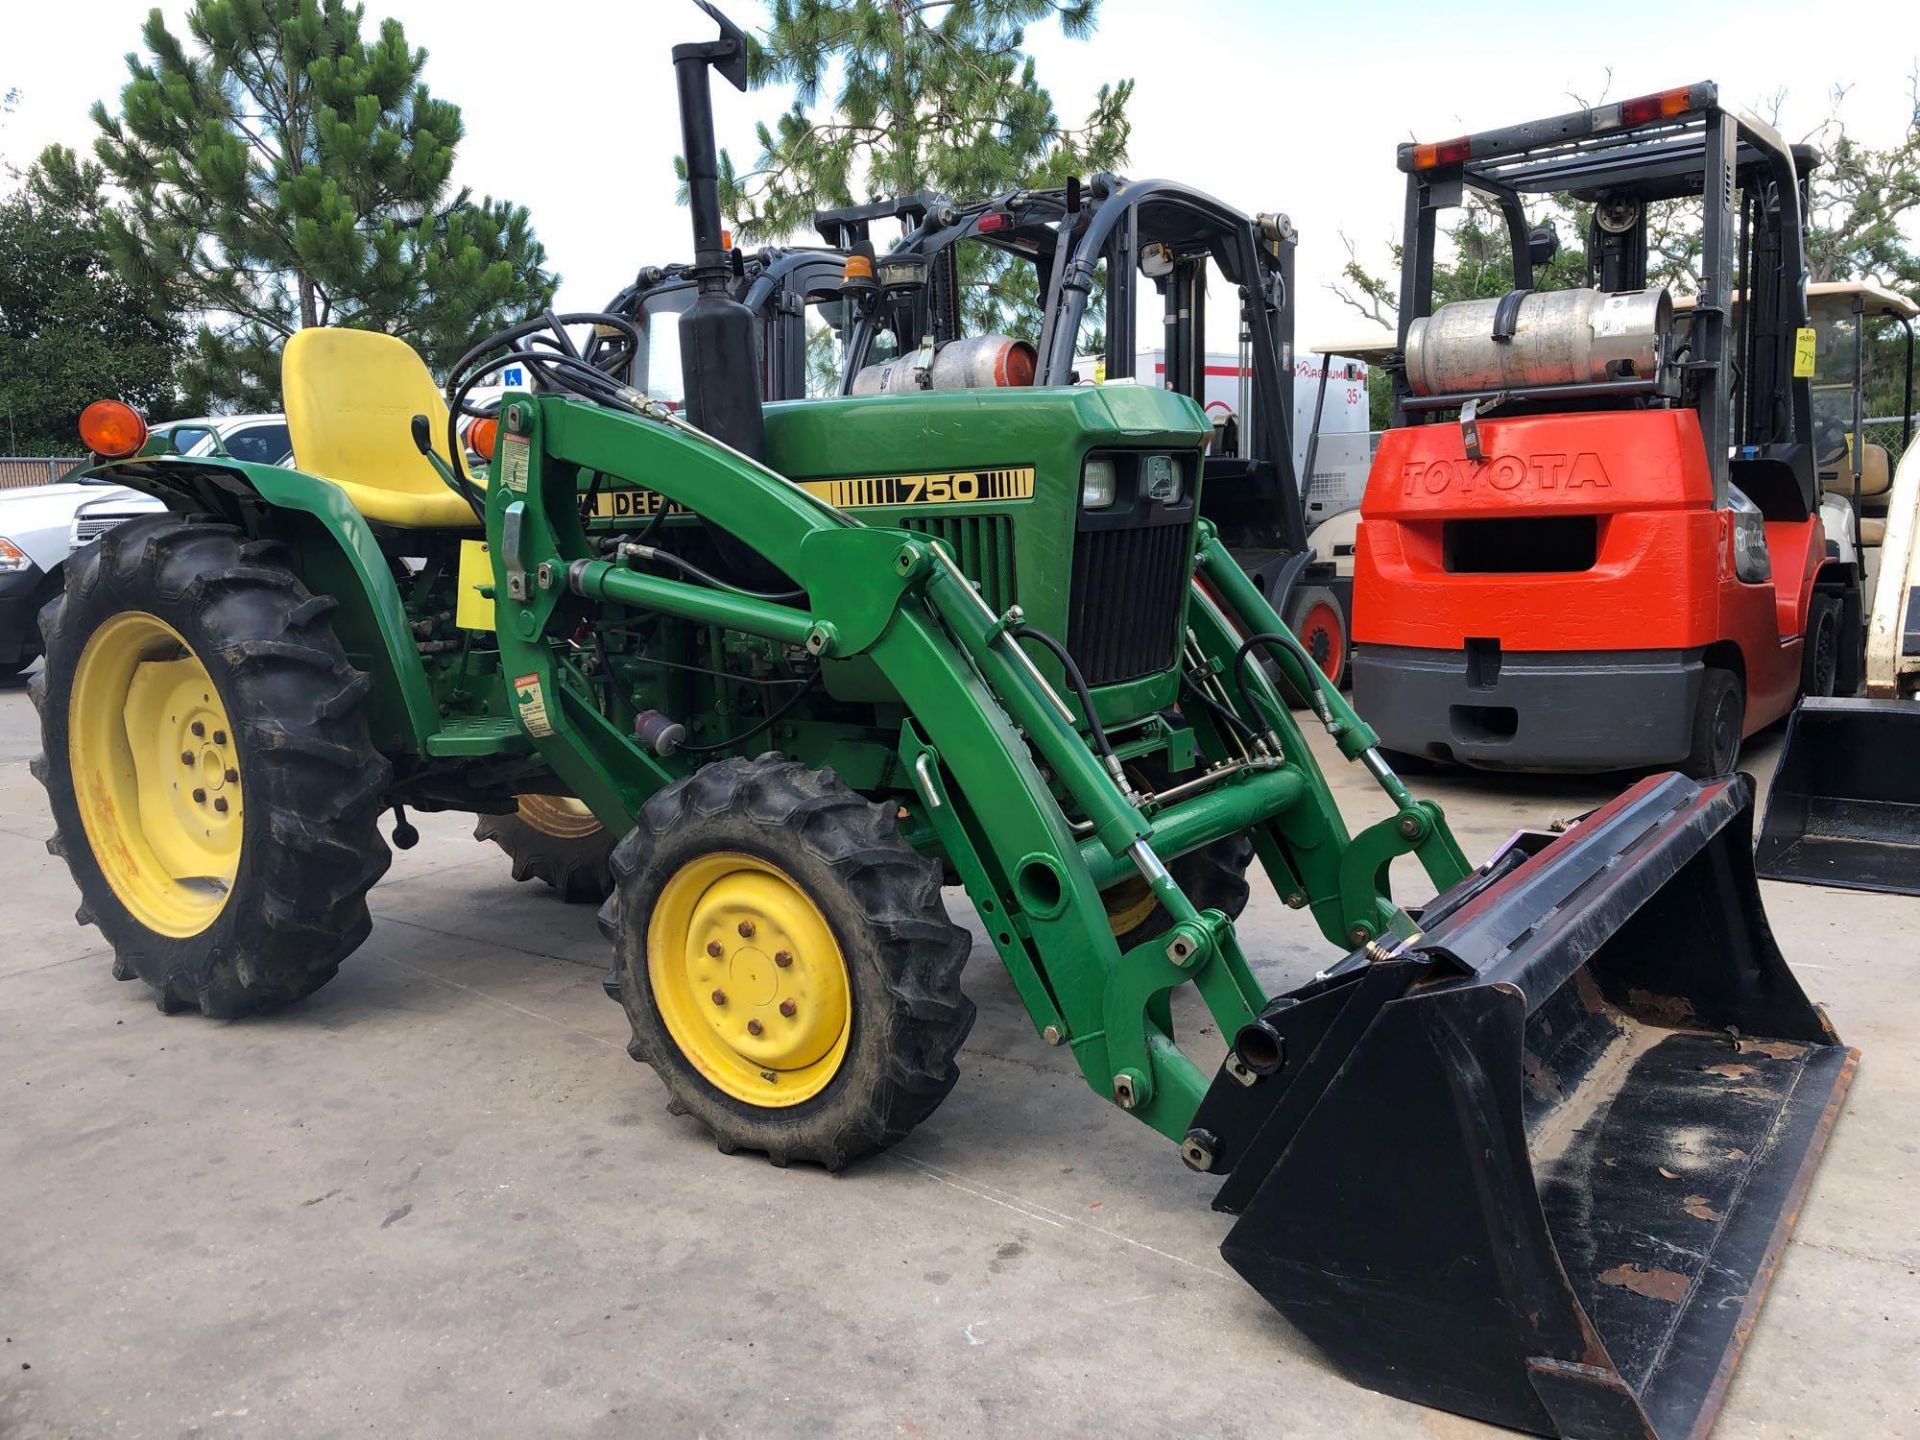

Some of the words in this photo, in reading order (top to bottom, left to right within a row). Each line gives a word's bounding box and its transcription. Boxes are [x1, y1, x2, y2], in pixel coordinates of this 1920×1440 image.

[1347, 388, 1358, 404] 35
[901, 472, 979, 504] 750
[1404, 453, 1612, 496] TOYOTA
[615, 491, 697, 516] DEE
